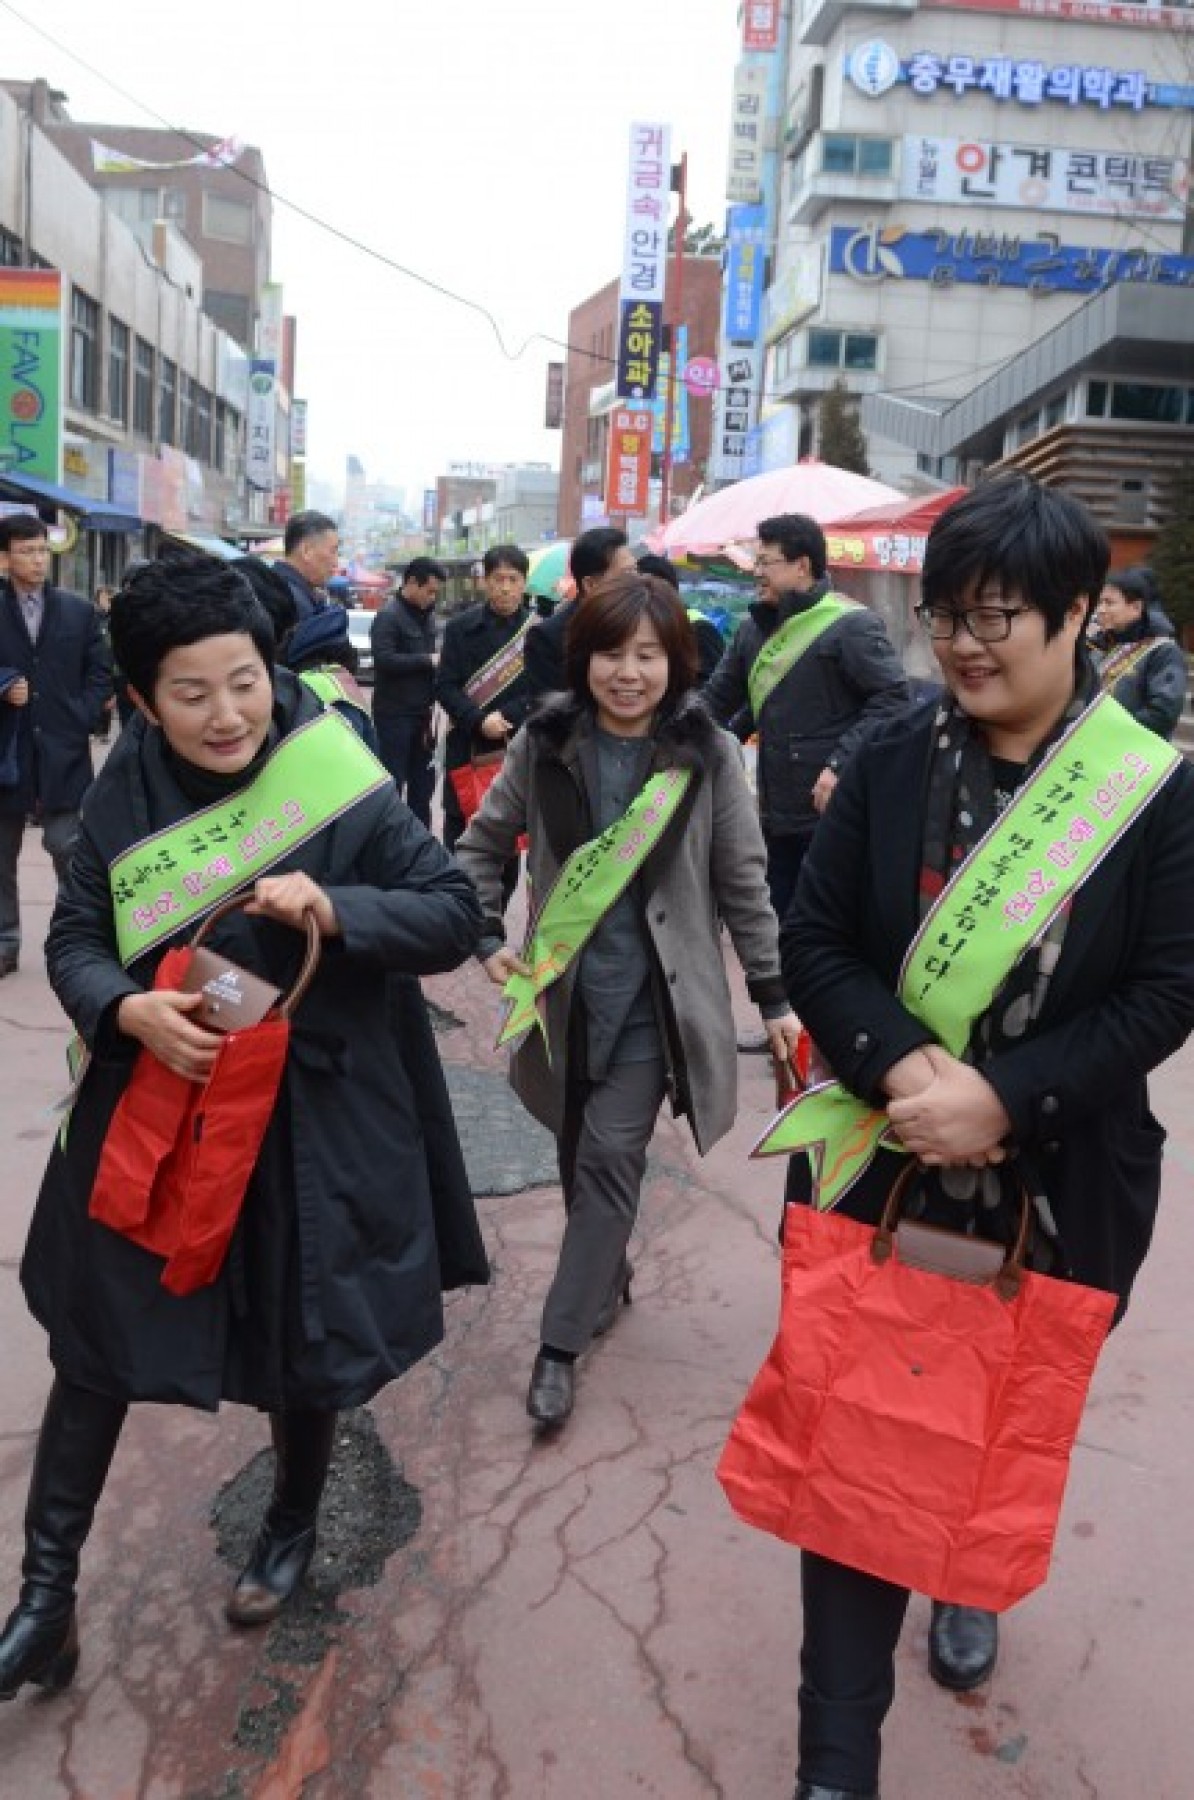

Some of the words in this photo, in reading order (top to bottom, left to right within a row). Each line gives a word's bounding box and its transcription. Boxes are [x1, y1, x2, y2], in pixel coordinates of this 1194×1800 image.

[908, 51, 1148, 110] 충무재활의학과
[630, 125, 664, 222] 귀금속
[955, 142, 1052, 206] 안경
[630, 228, 659, 292] 안경
[625, 303, 654, 387] 소아과
